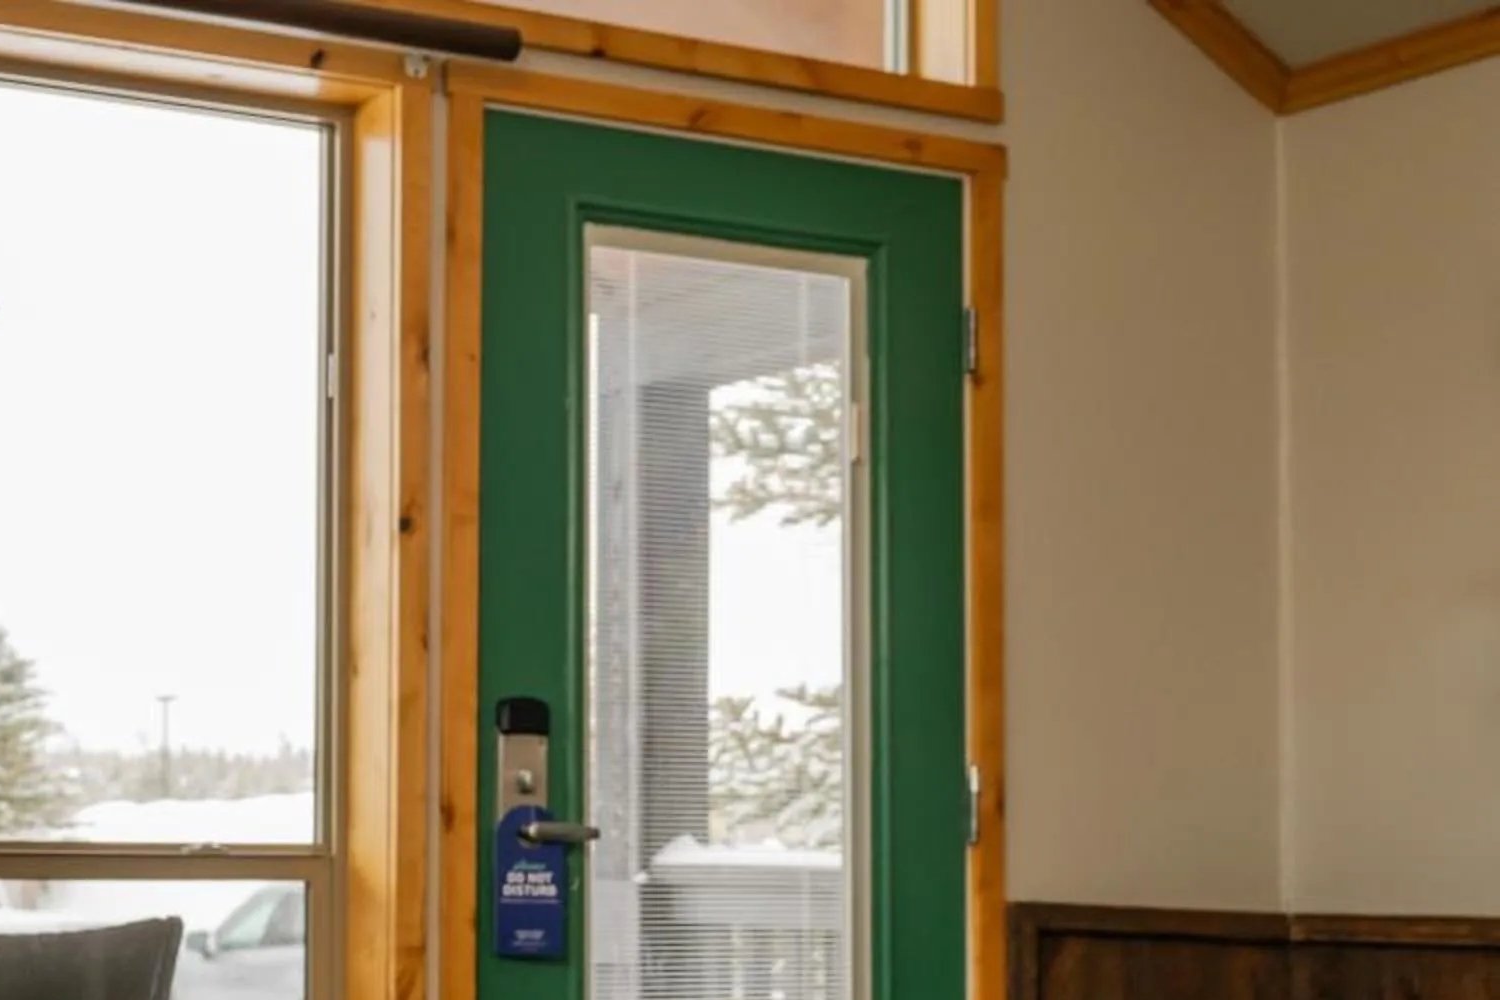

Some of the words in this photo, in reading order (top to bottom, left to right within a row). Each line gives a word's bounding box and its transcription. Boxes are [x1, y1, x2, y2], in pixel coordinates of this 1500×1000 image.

[506, 871, 525, 883] DO
[527, 871, 553, 883] NOT
[502, 884, 557, 896] DISTURB
